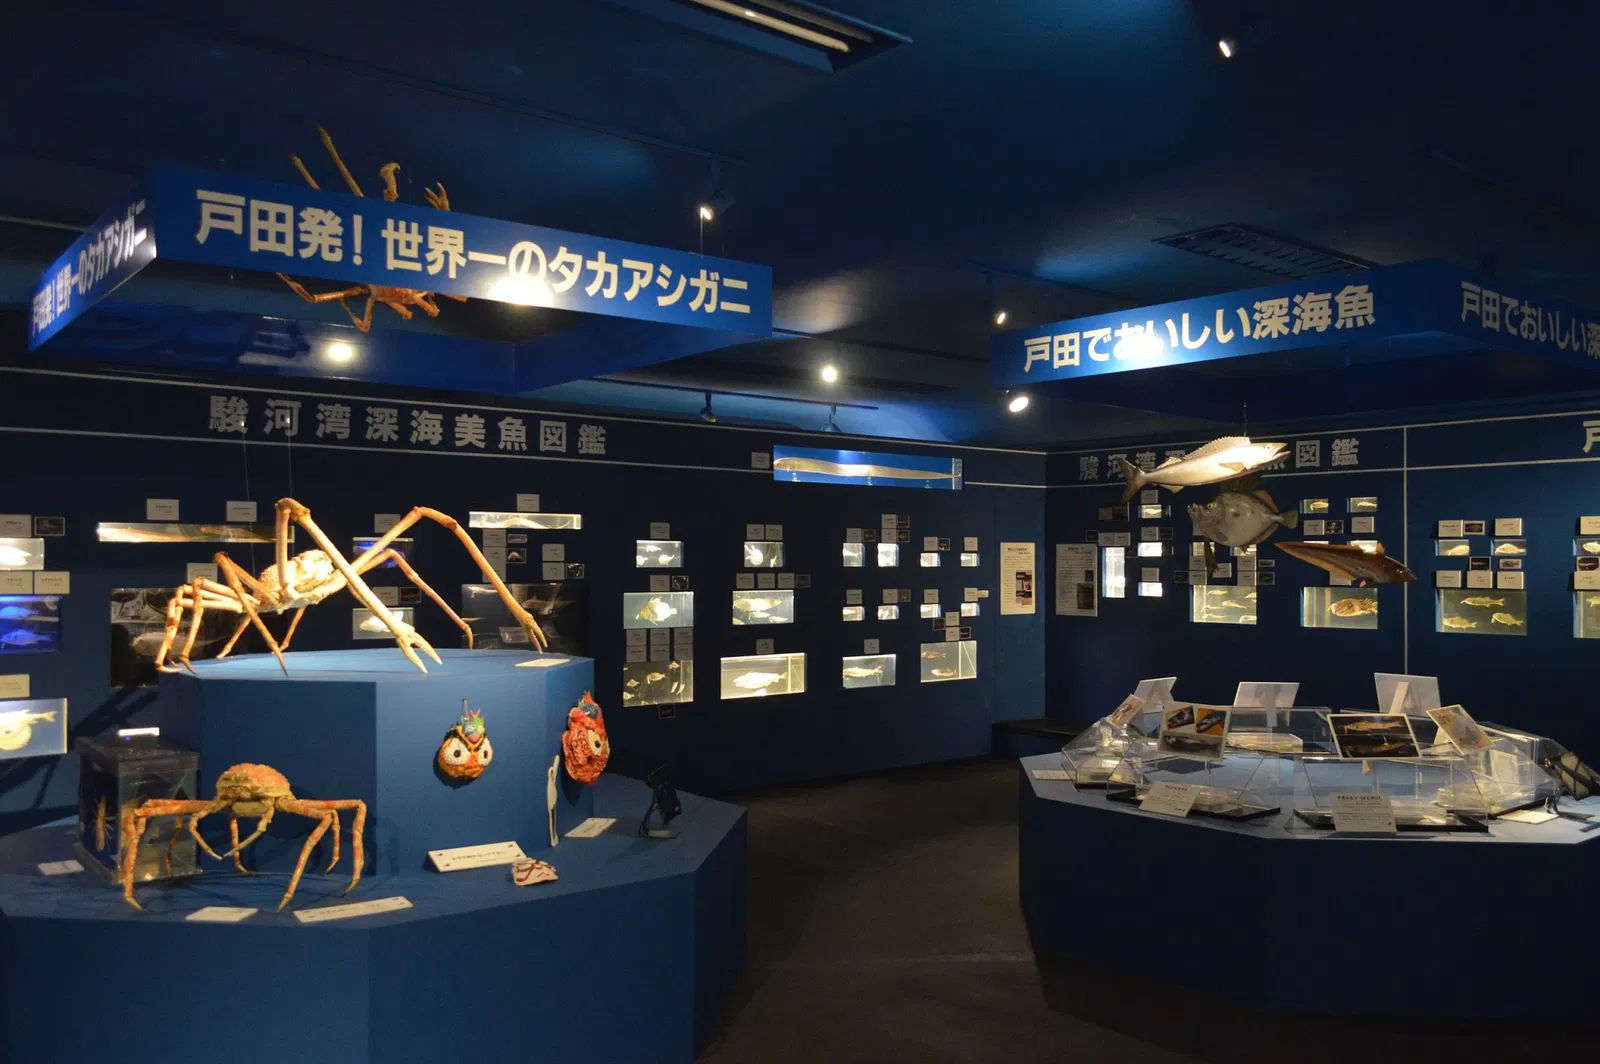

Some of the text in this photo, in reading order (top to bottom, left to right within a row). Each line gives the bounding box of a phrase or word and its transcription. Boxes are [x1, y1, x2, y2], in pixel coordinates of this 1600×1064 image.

[196, 189, 750, 315] 戸田発！世界一のタカアシガニ
[1023, 284, 1375, 373] 戸田でおいしい深海魚
[208, 395, 607, 454] 駿河湾深海美魚図鑑
